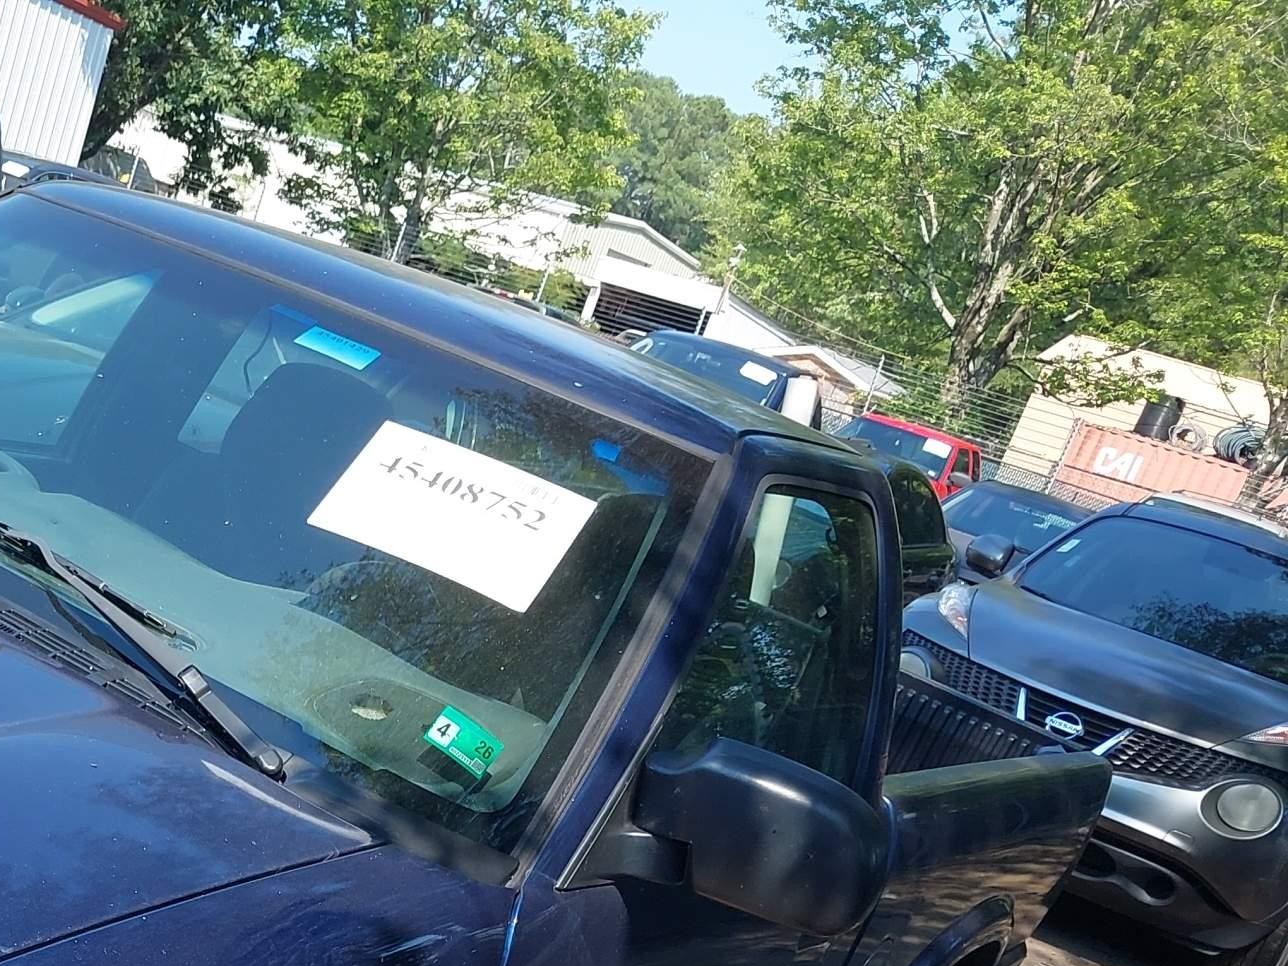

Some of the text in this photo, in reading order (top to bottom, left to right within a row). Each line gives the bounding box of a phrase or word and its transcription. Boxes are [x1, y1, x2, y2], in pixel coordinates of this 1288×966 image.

[1094, 447, 1144, 482] CAI
[379, 456, 546, 531] 45408752
[436, 723, 451, 738] 4
[474, 740, 495, 760] 26
